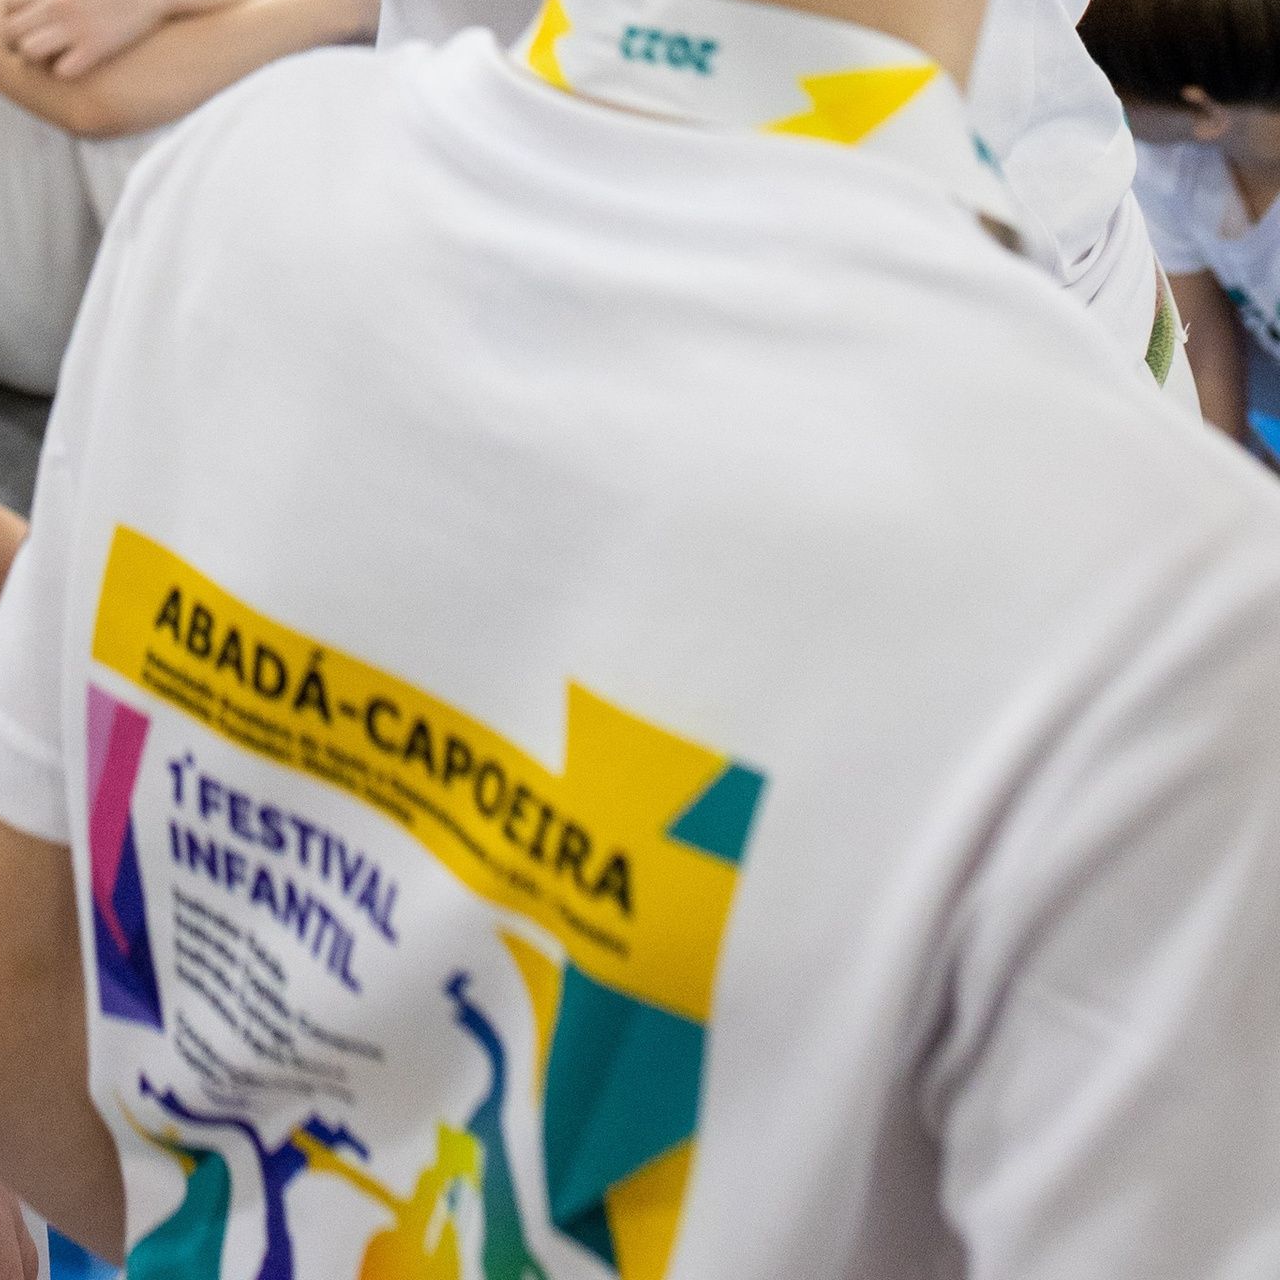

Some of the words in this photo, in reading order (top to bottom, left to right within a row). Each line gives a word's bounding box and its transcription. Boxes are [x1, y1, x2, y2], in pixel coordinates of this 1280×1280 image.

[154, 585, 634, 918] ABADÁ-CAPOEIRA
[169, 819, 363, 996] INFANTIL
[199, 774, 398, 945] FESTIVAL
